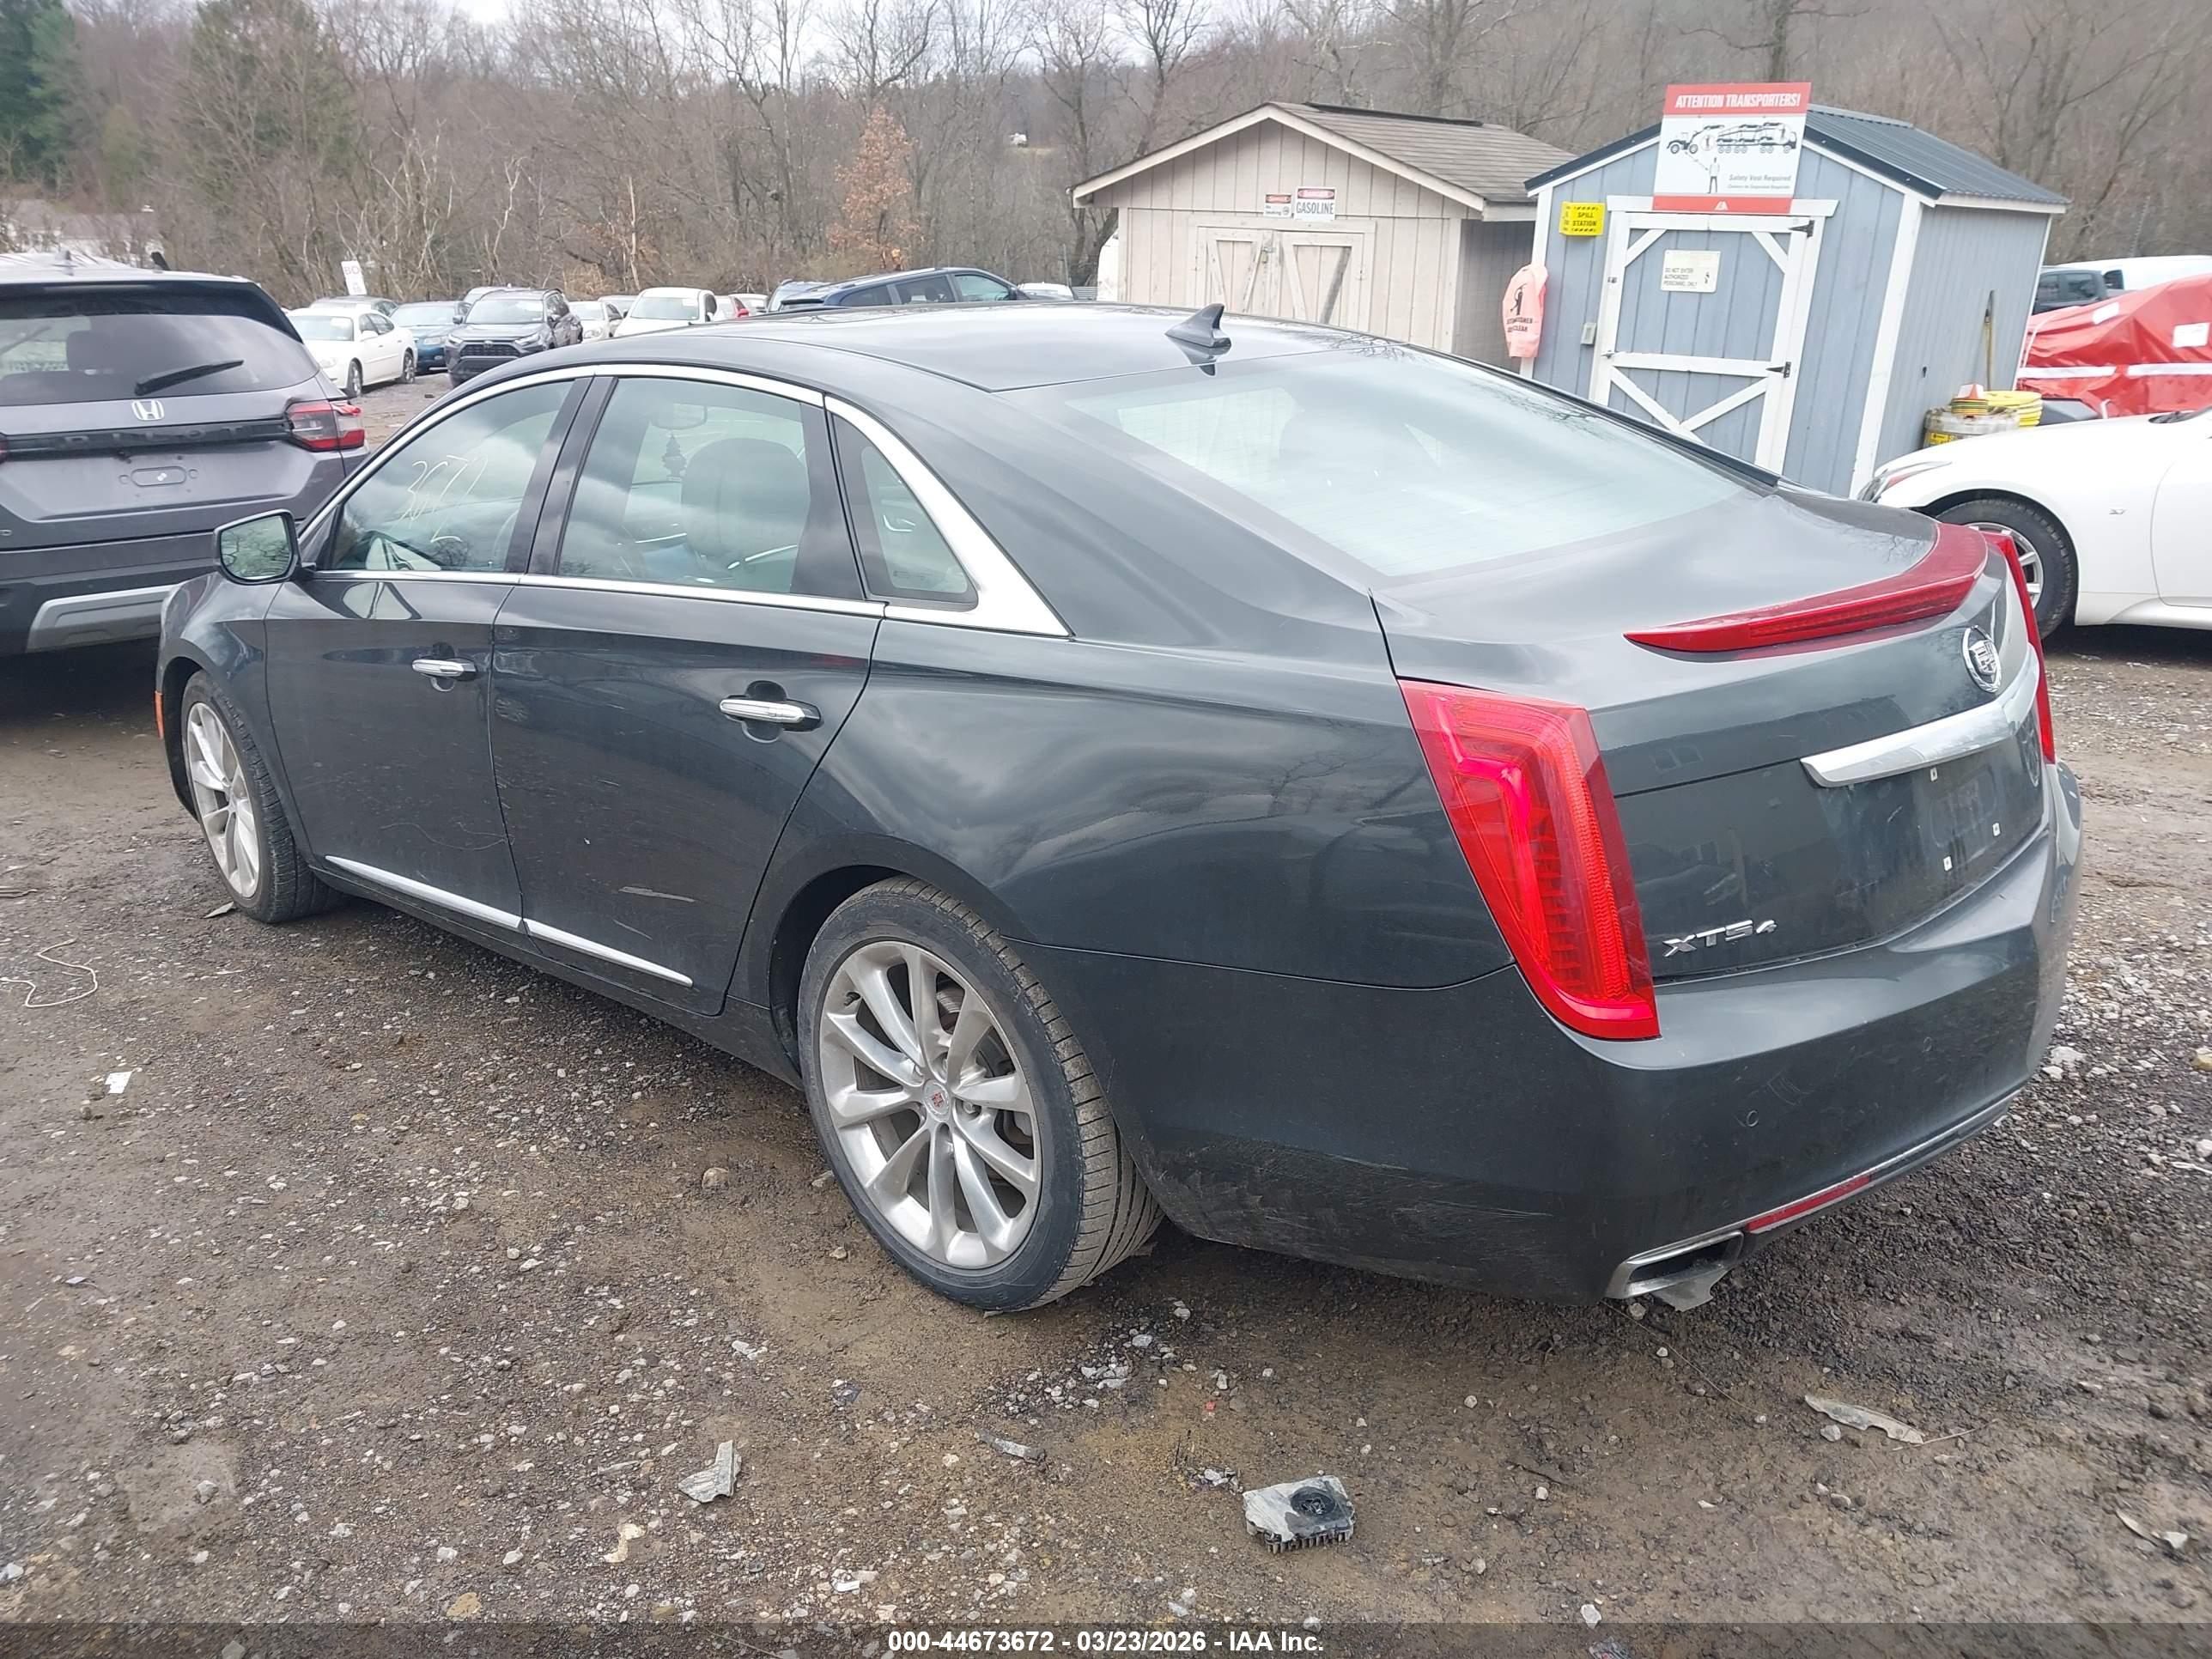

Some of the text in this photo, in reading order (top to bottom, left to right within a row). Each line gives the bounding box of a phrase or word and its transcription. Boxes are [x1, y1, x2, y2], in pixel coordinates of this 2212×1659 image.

[1675, 93, 1801, 108] ATTENTION TRANSPORTERS!
[1296, 202, 1334, 215] GASOLINE
